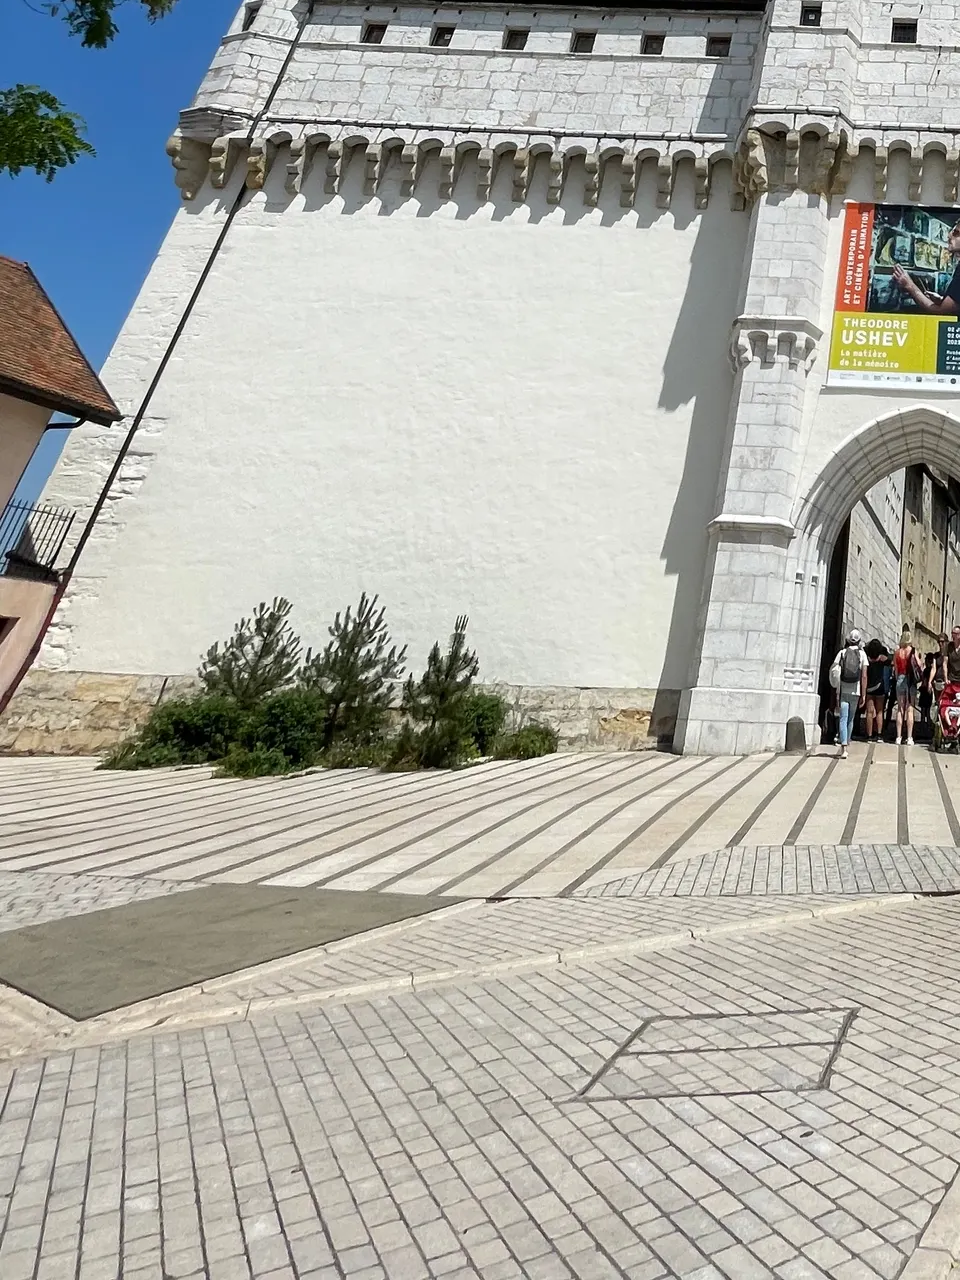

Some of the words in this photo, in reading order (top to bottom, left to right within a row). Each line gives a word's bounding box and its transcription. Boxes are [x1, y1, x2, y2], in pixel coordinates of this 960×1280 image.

[845, 229, 858, 286] CONTEMPORAIN
[854, 262, 864, 291] CINÉMA
[843, 289, 852, 305] ART
[853, 293, 861, 305] ET
[843, 317, 908, 330] THEODORE
[841, 329, 909, 347] USHEV
[840, 349, 850, 357] La
[853, 349, 887, 358] matière
[839, 358, 850, 366] de
[853, 358, 862, 367] la
[865, 360, 899, 368] mémoire
